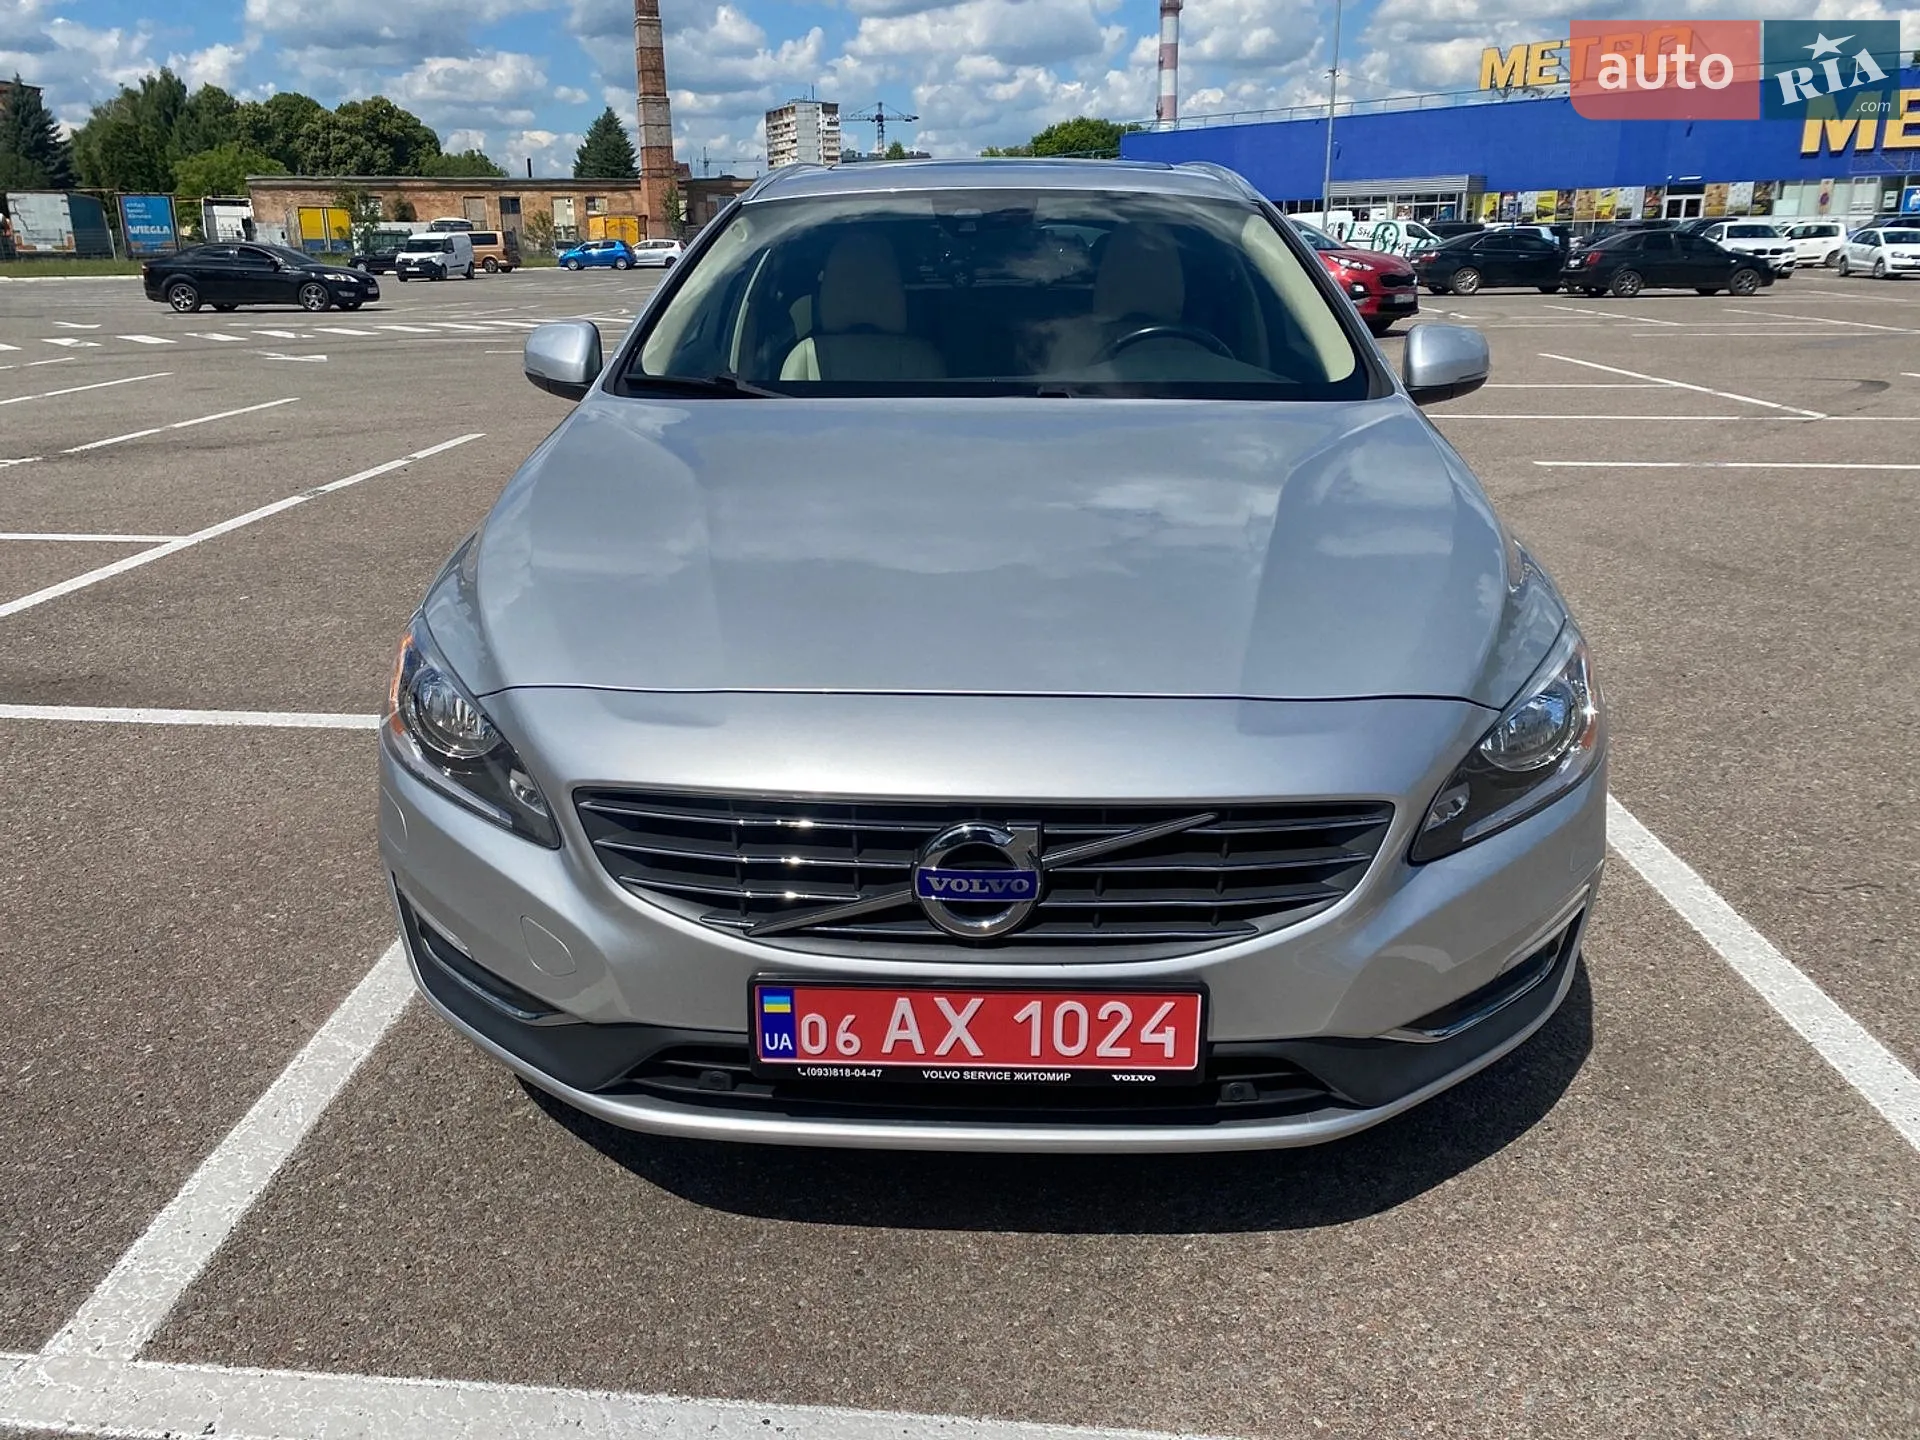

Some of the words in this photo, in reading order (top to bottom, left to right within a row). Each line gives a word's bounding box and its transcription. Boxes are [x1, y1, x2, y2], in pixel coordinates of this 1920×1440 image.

[1480, 26, 1693, 91] METRO
[925, 876, 1030, 893] VOLVO
[800, 1013, 862, 1056] 06
[881, 997, 984, 1056] AX
[1013, 1000, 1176, 1058] 1024
[765, 1032, 793, 1051] UA
[806, 1067, 882, 1078] (093)818-04-47
[922, 1070, 960, 1079] VOLVO
[963, 1070, 1011, 1081] SERVICE
[1013, 1071, 1072, 1082] ЖИТОМИР
[1112, 1074, 1156, 1082] VOLVO
